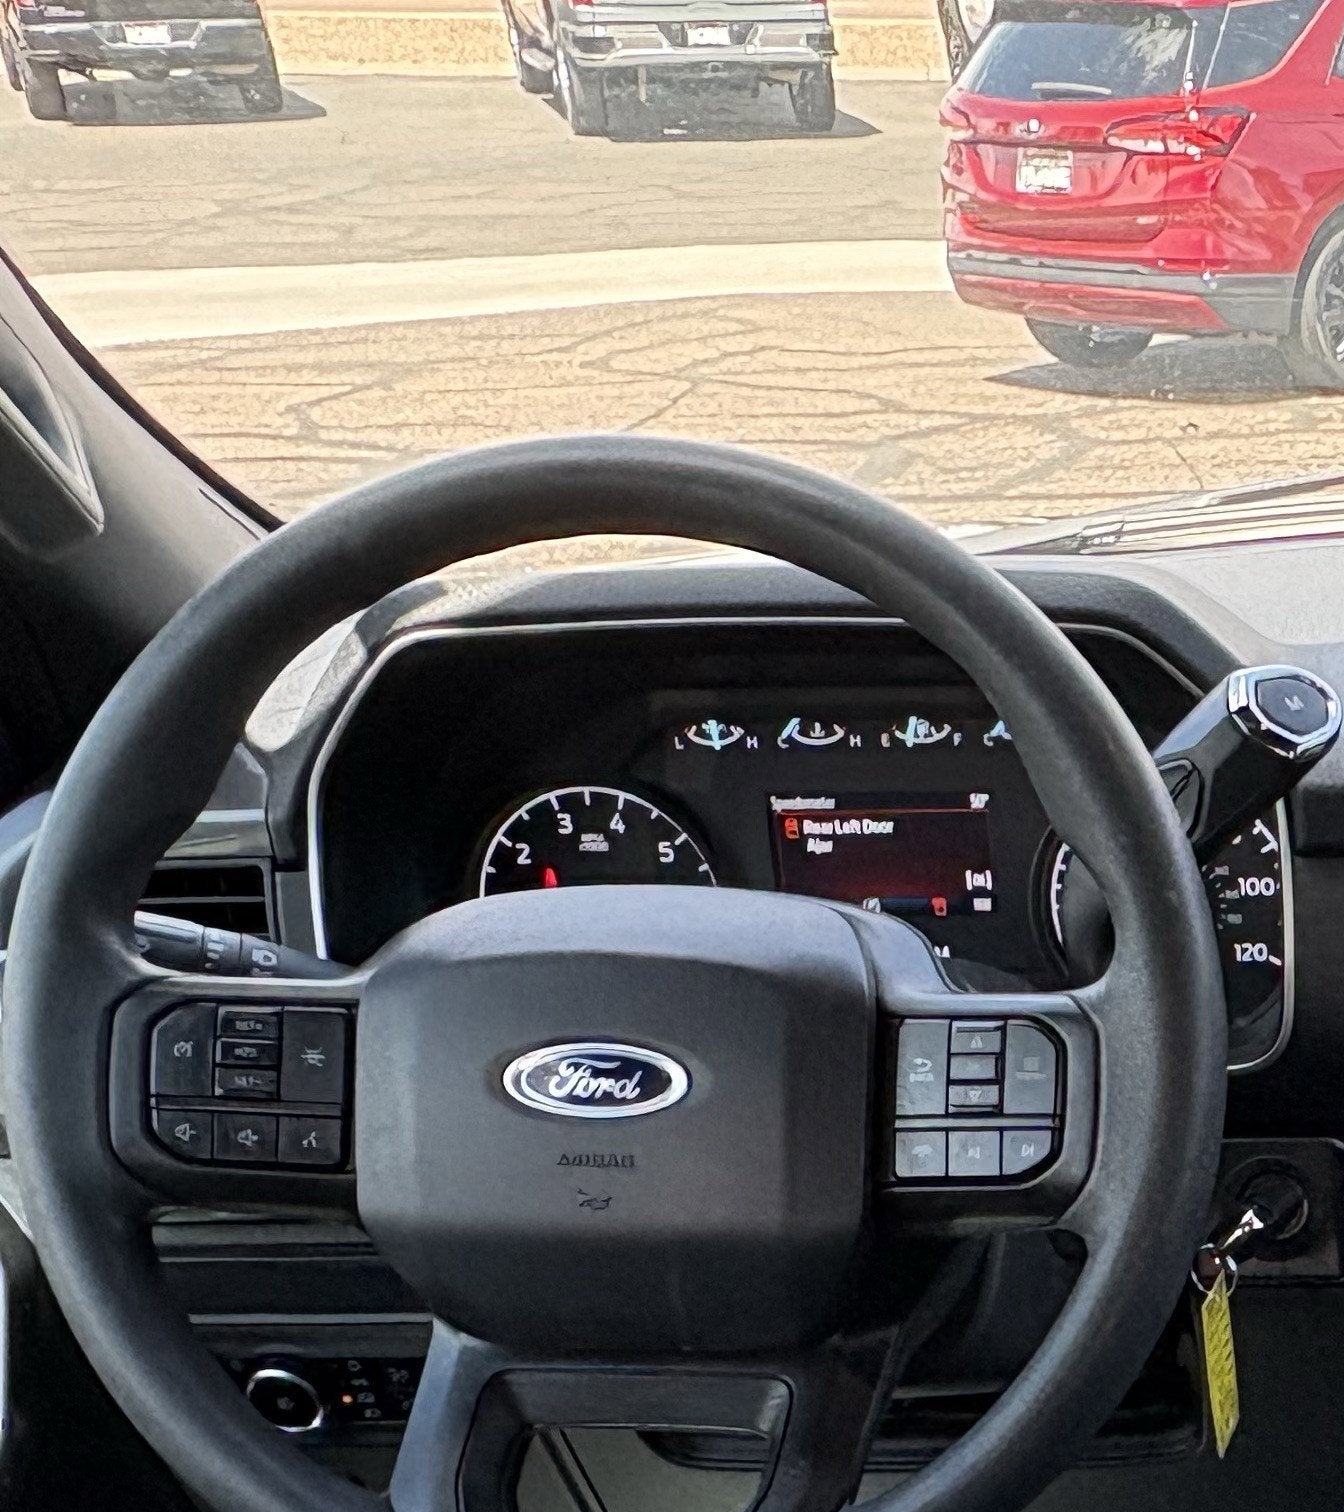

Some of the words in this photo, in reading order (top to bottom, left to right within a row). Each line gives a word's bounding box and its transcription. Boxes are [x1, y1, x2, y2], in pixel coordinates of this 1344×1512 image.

[556, 812, 574, 835] 3
[609, 812, 626, 835] 4
[515, 843, 533, 865] 2
[658, 841, 675, 864] 5
[1237, 877, 1276, 897] 100
[1233, 943, 1268, 962] 120
[548, 1056, 644, 1100] Ford
